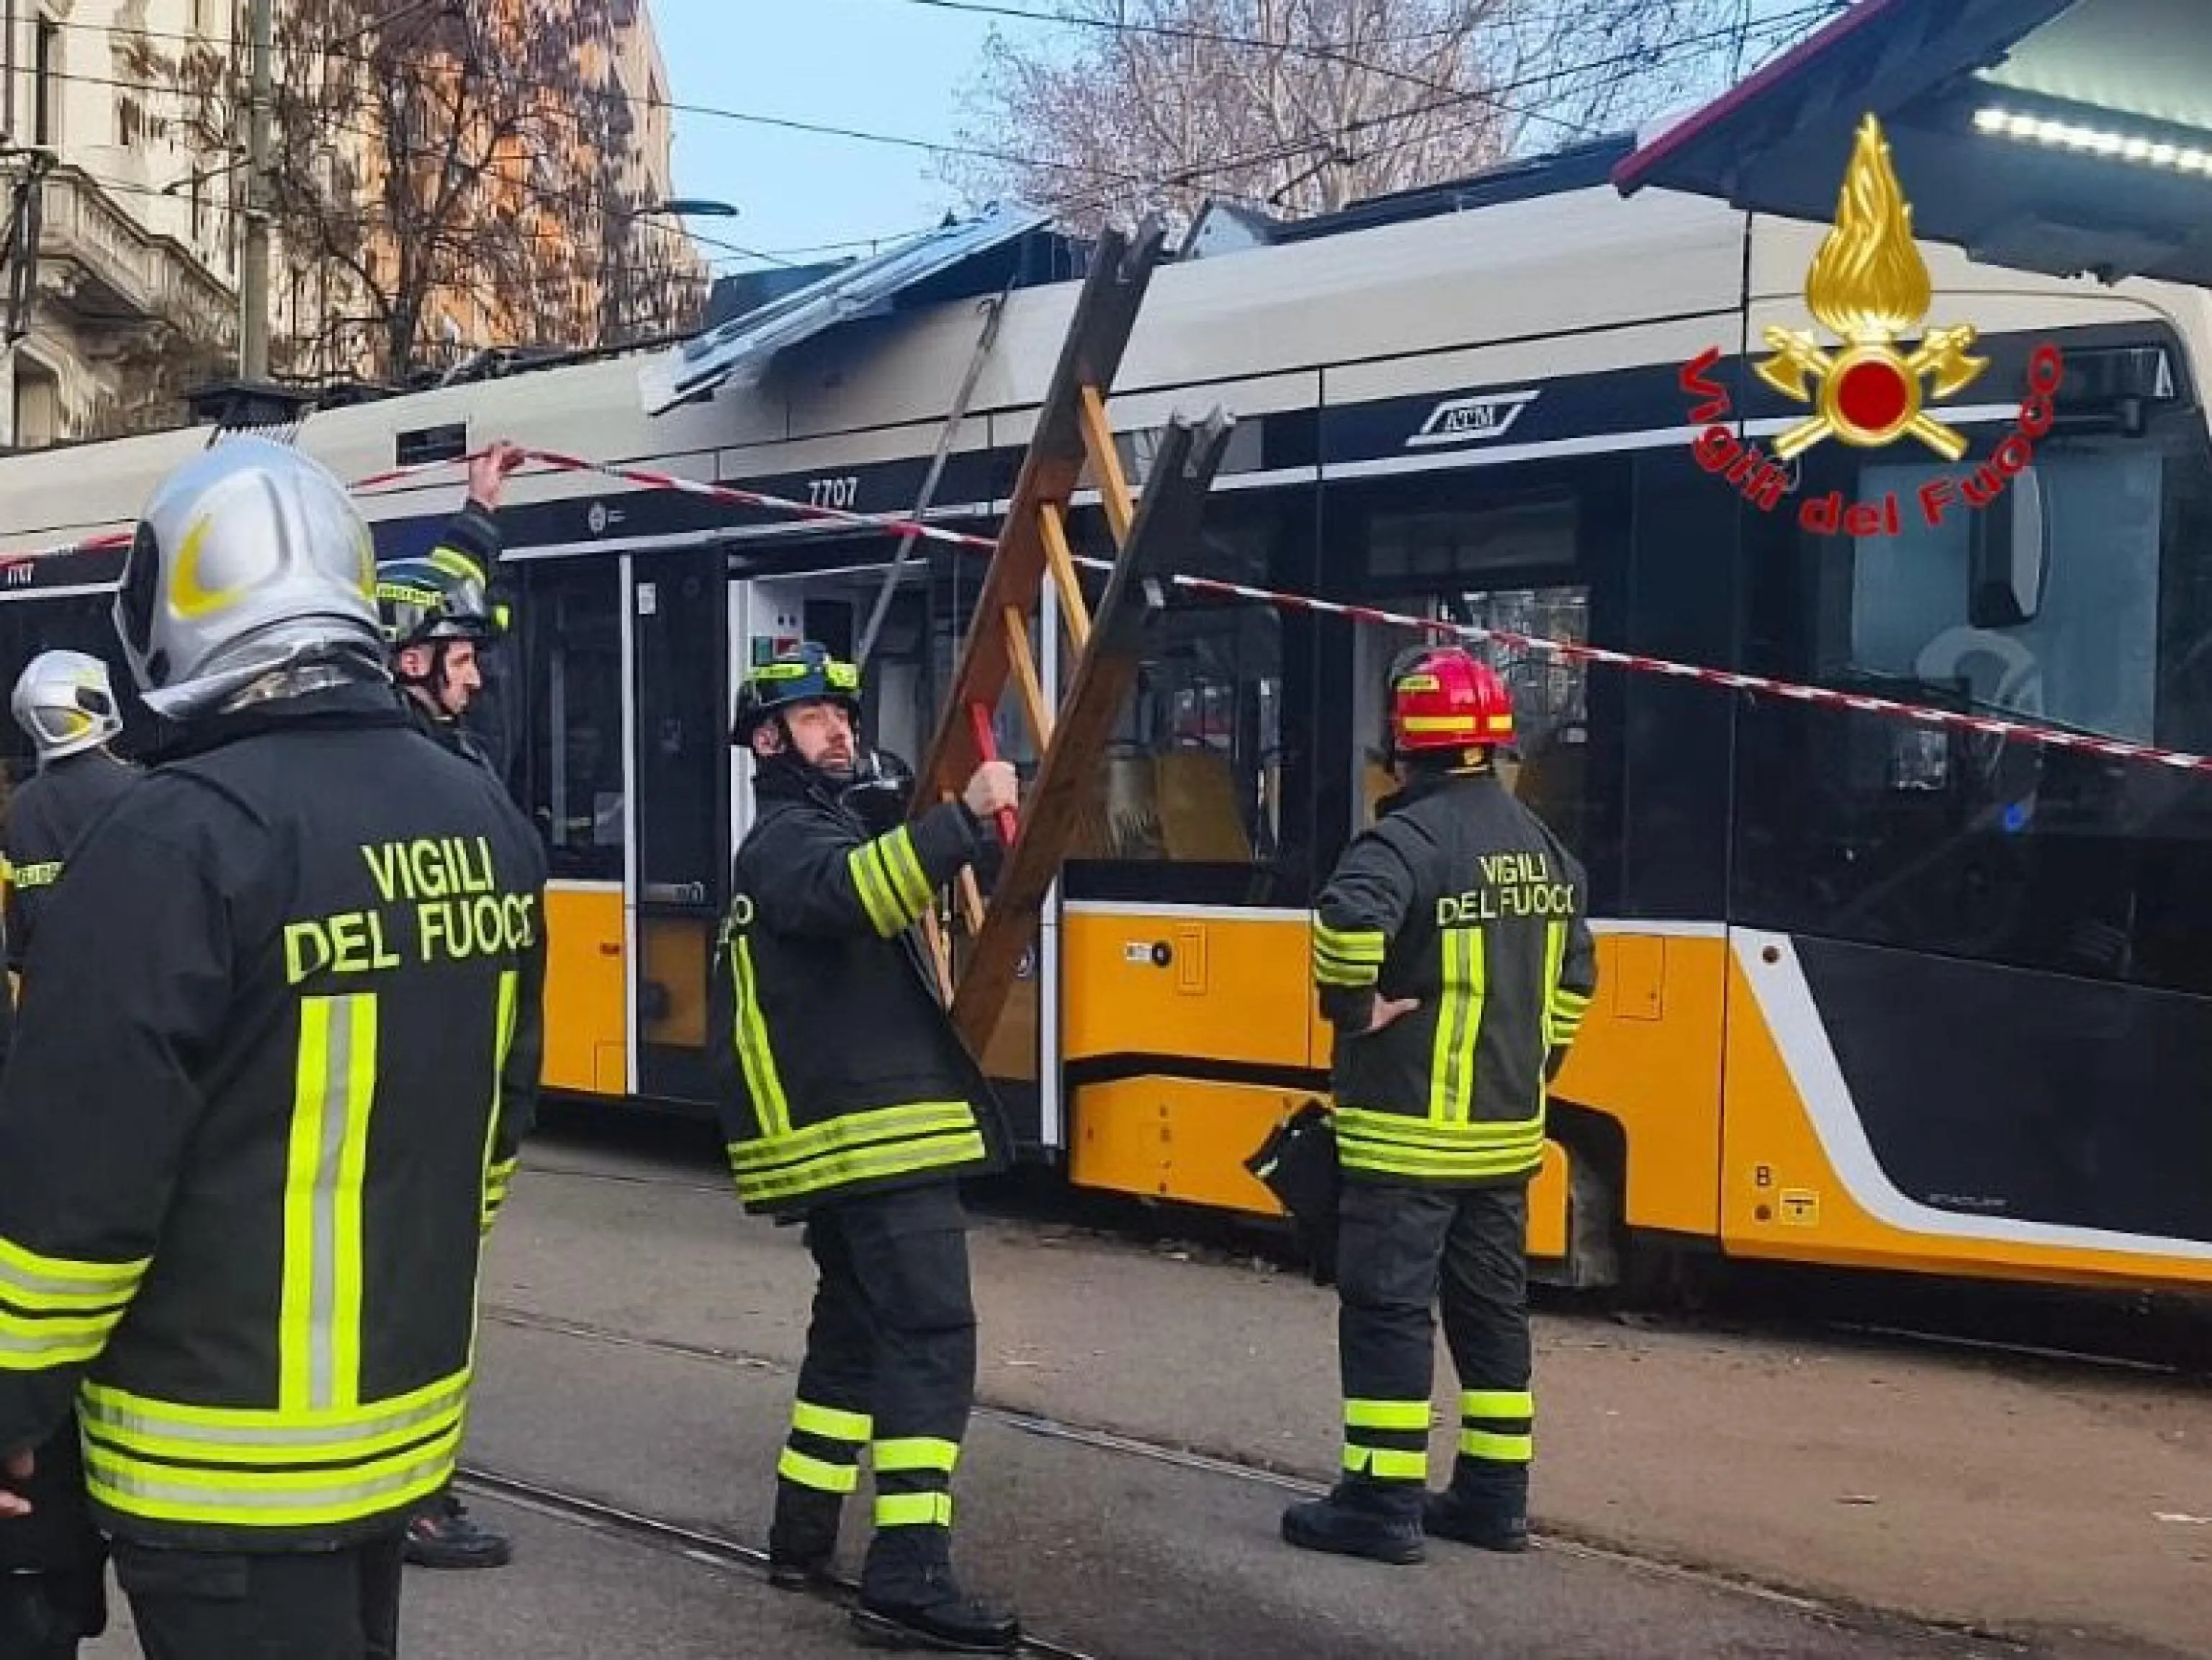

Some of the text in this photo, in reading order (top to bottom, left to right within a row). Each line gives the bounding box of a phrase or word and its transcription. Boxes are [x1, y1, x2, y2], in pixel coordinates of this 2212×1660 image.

[808, 476, 858, 508] 7707
[360, 836, 495, 902] VIGILI
[1477, 853, 1547, 884] VIGILI
[1437, 889, 1497, 927] DEL
[284, 909, 400, 984] DEL
